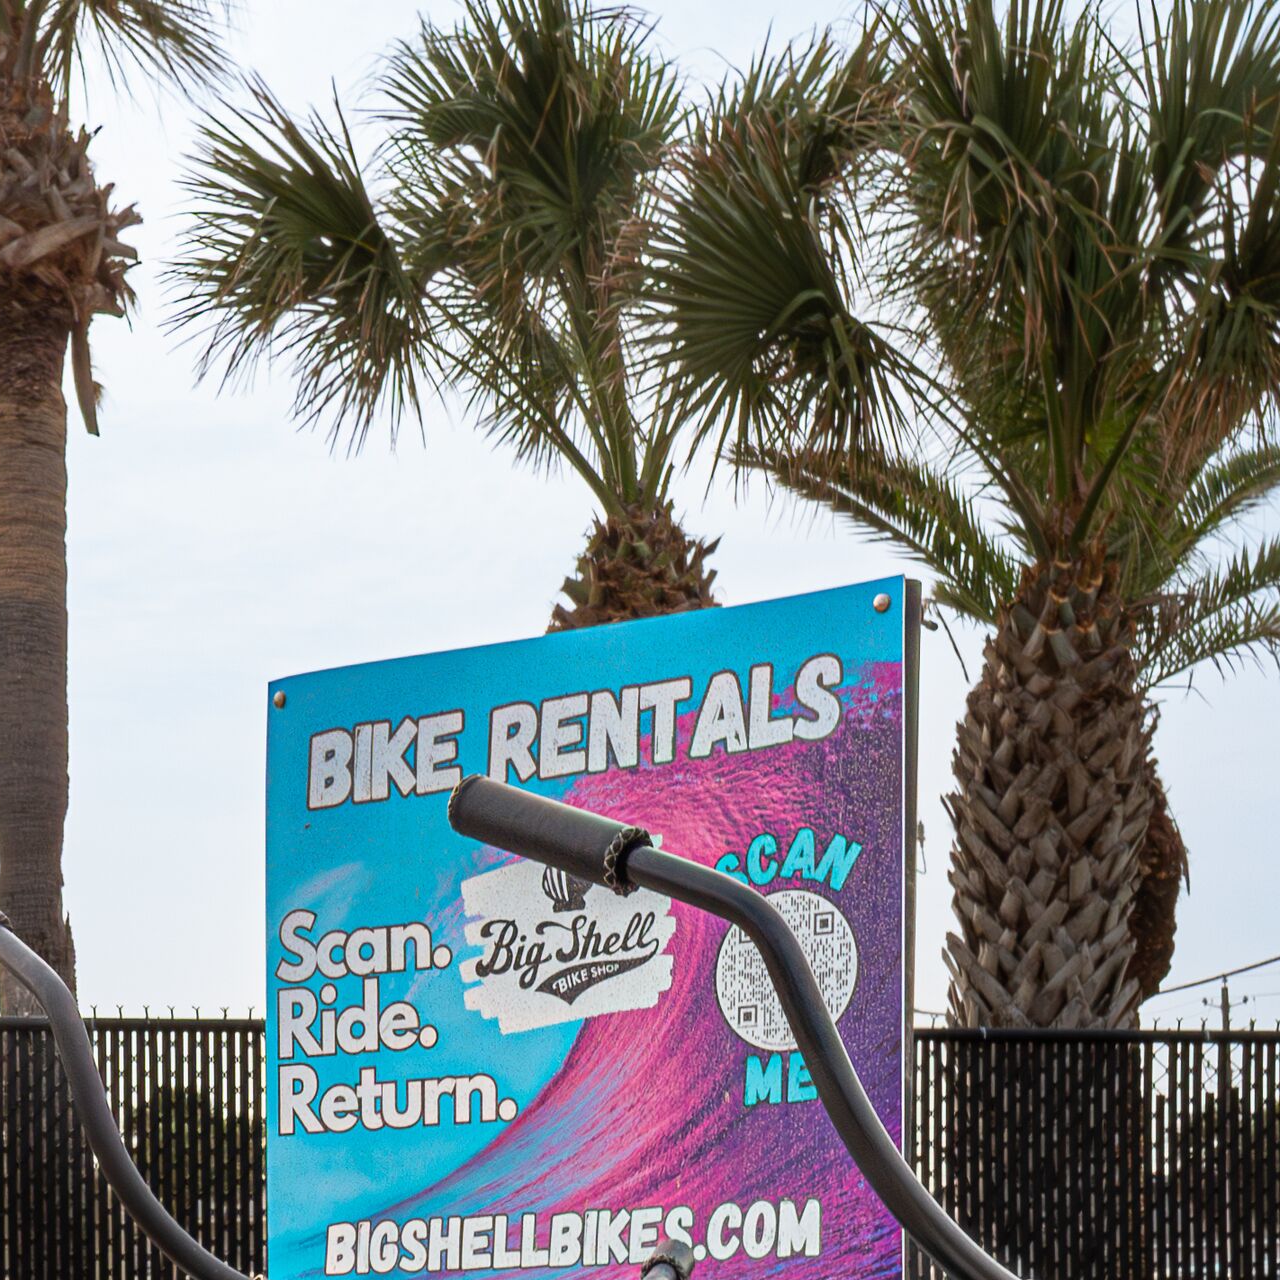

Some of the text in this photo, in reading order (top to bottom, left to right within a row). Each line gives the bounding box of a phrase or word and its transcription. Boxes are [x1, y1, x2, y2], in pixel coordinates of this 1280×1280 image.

[306, 653, 844, 811] BIKE RENTALS
[275, 908, 453, 983] Scan.
[475, 911, 659, 989] Big Shell
[552, 962, 620, 994] BIKE SHOP
[277, 976, 439, 1060] Ride.
[277, 1062, 519, 1136] Return.
[743, 1050, 818, 1106] ME
[324, 1198, 821, 1276] BIGSHELLBIKES.COM
